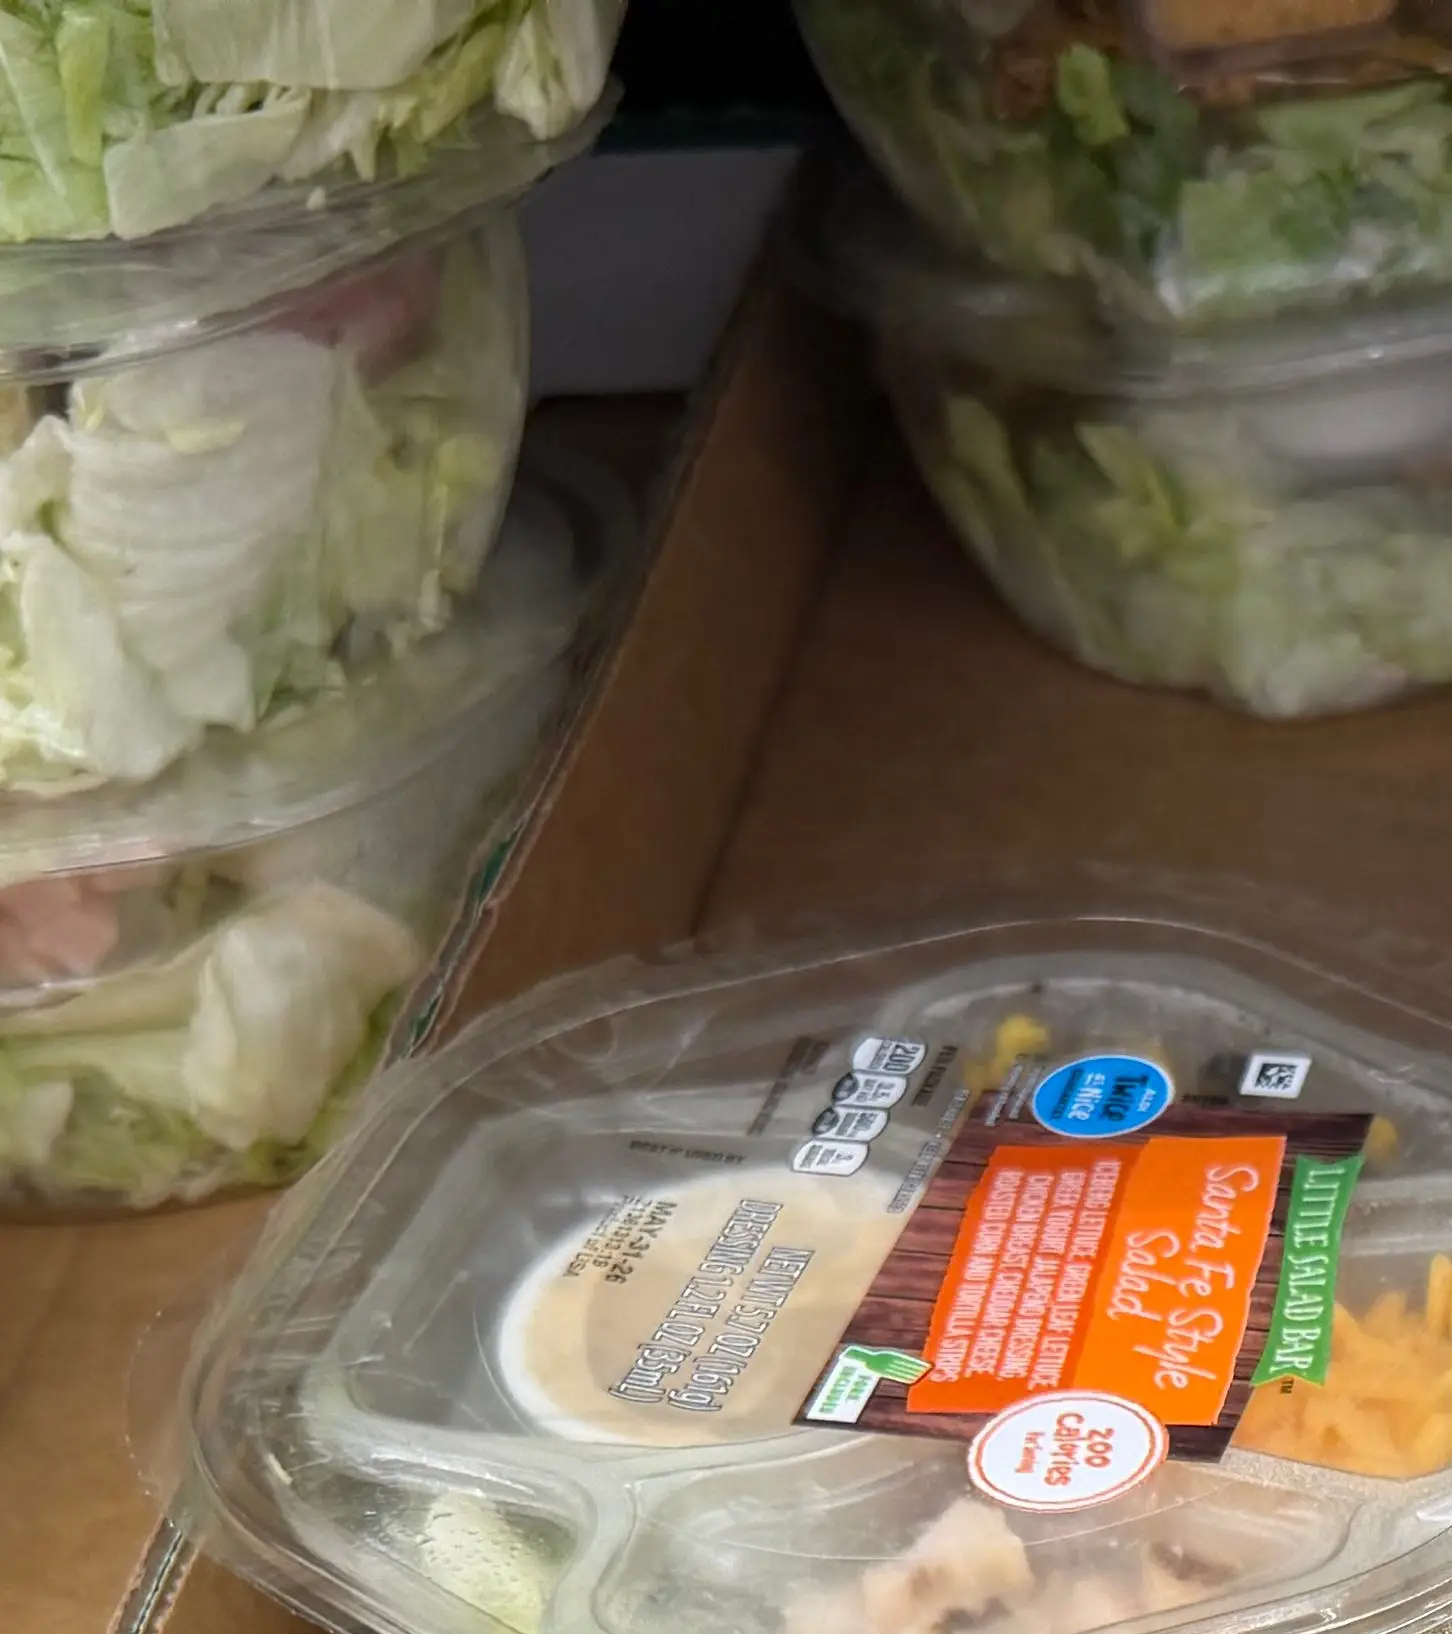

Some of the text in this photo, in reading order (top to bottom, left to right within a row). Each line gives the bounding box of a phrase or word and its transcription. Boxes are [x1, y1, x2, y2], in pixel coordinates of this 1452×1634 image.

[883, 1042, 920, 1072] 200
[1067, 1086, 1103, 1122] Nice
[1105, 1073, 1148, 1122] Twice
[984, 1169, 1023, 1222] ROASTED
[1188, 1165, 1259, 1254] Santa
[605, 1200, 678, 1284] MAY-31-26
[972, 1221, 1008, 1257] CORN
[982, 1173, 1054, 1328] CHICKEN CHEDDAR
[1037, 1205, 1075, 1255] YOGURT
[1047, 1159, 1122, 1334] ICEBERG GREEN LEAF
[758, 1246, 816, 1283] NET
[964, 1256, 997, 1282] AND
[1106, 1227, 1180, 1322] Salad
[1177, 1257, 1235, 1298] Fe
[1269, 1167, 1346, 1374] LITTLE SALAD BAR
[608, 1199, 784, 1404] DRESSING FL OZ (35mL)
[946, 1281, 989, 1337] TORTILLA
[708, 1332, 761, 1359] OZ
[929, 1336, 970, 1382] STRIPS
[1132, 1306, 1224, 1390] Style
[668, 1355, 748, 1412] (161g)
[1043, 1411, 1085, 1487] Calories
[1083, 1426, 1114, 1470] 200
